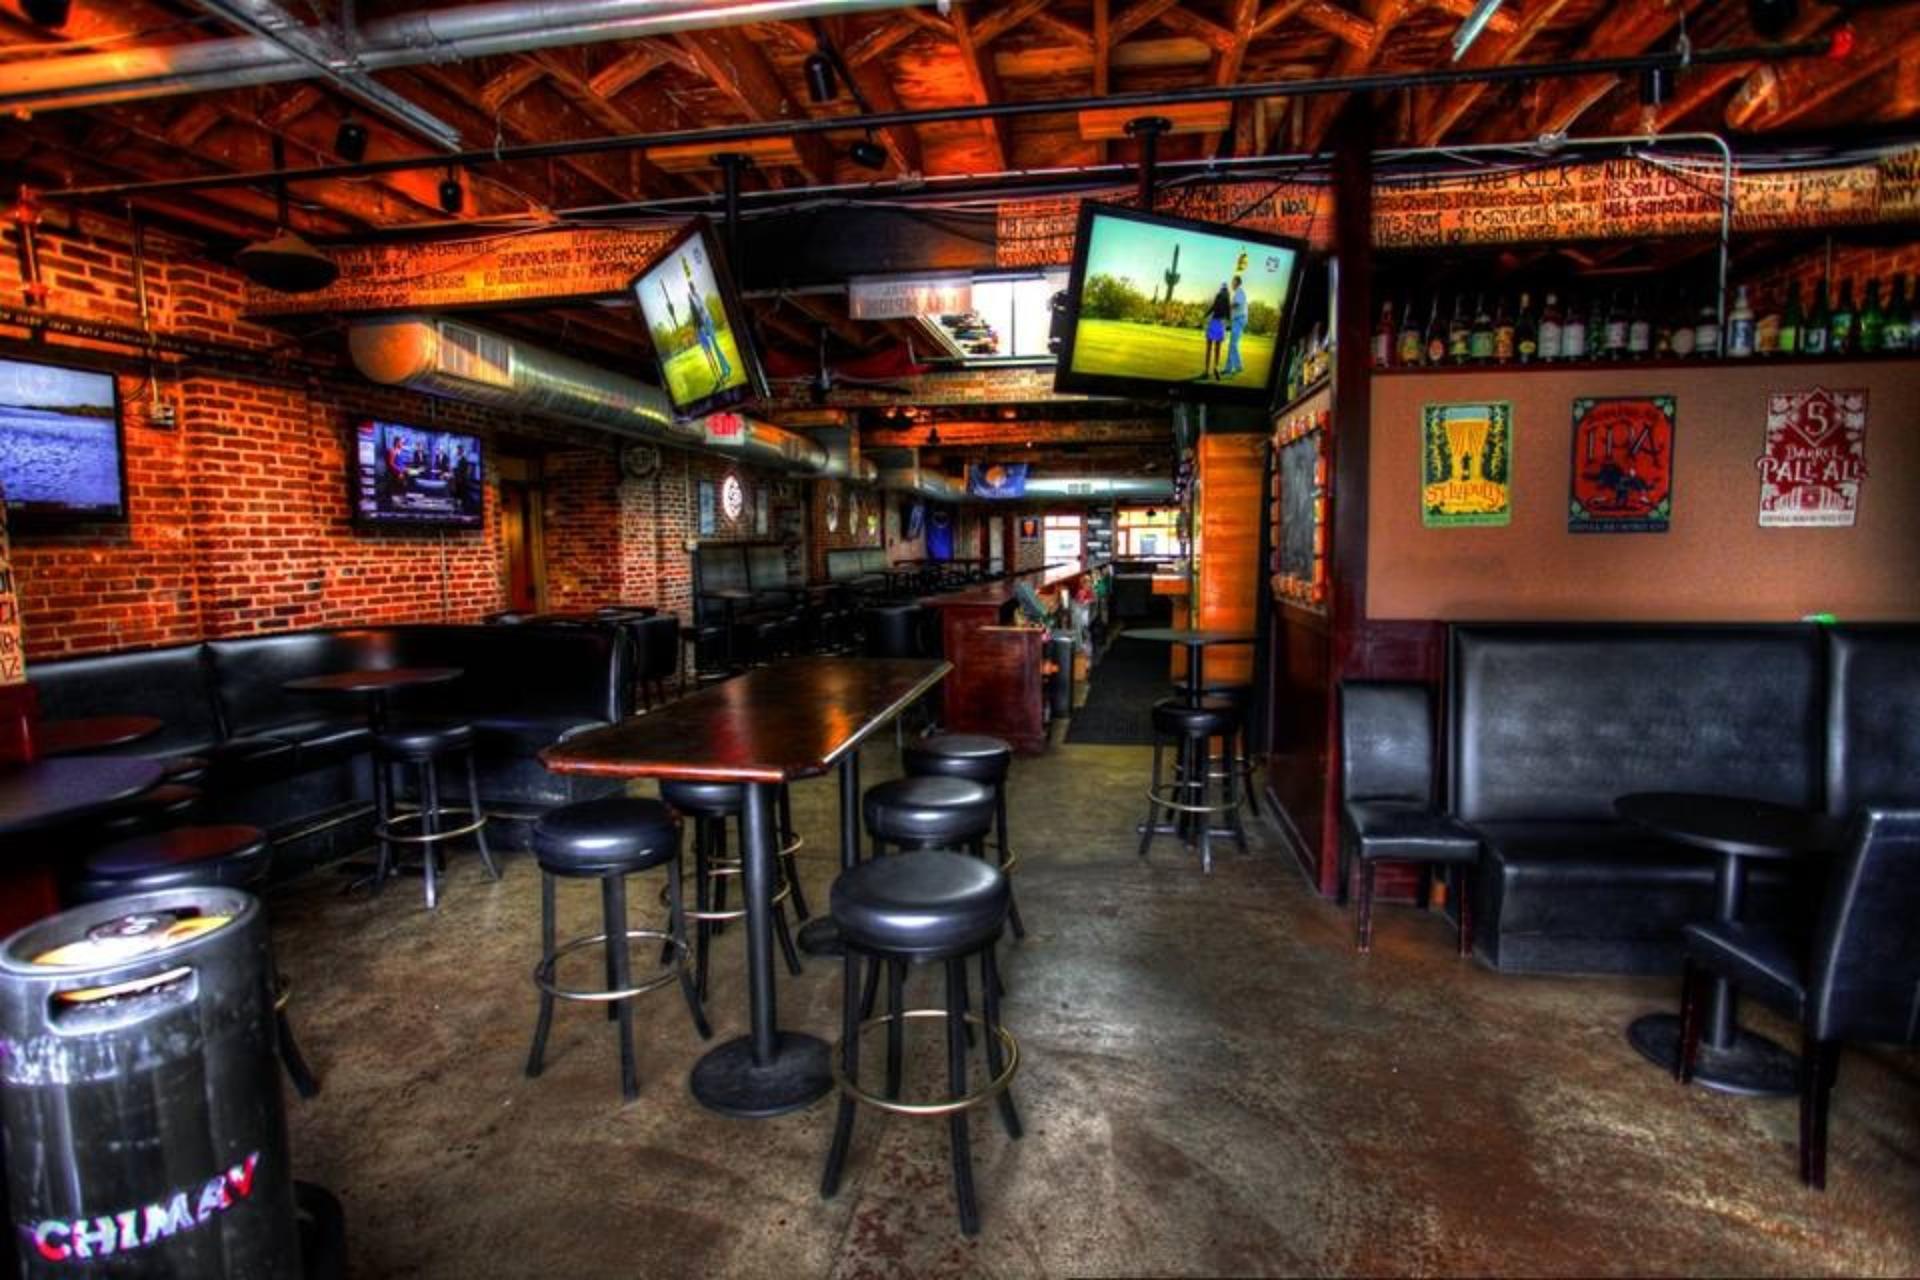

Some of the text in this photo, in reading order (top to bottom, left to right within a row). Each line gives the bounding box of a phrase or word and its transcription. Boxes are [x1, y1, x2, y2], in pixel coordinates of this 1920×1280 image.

[1584, 418, 1663, 467] IPA
[1807, 401, 1829, 437] 5
[34, 1151, 259, 1262] CHIMAY
